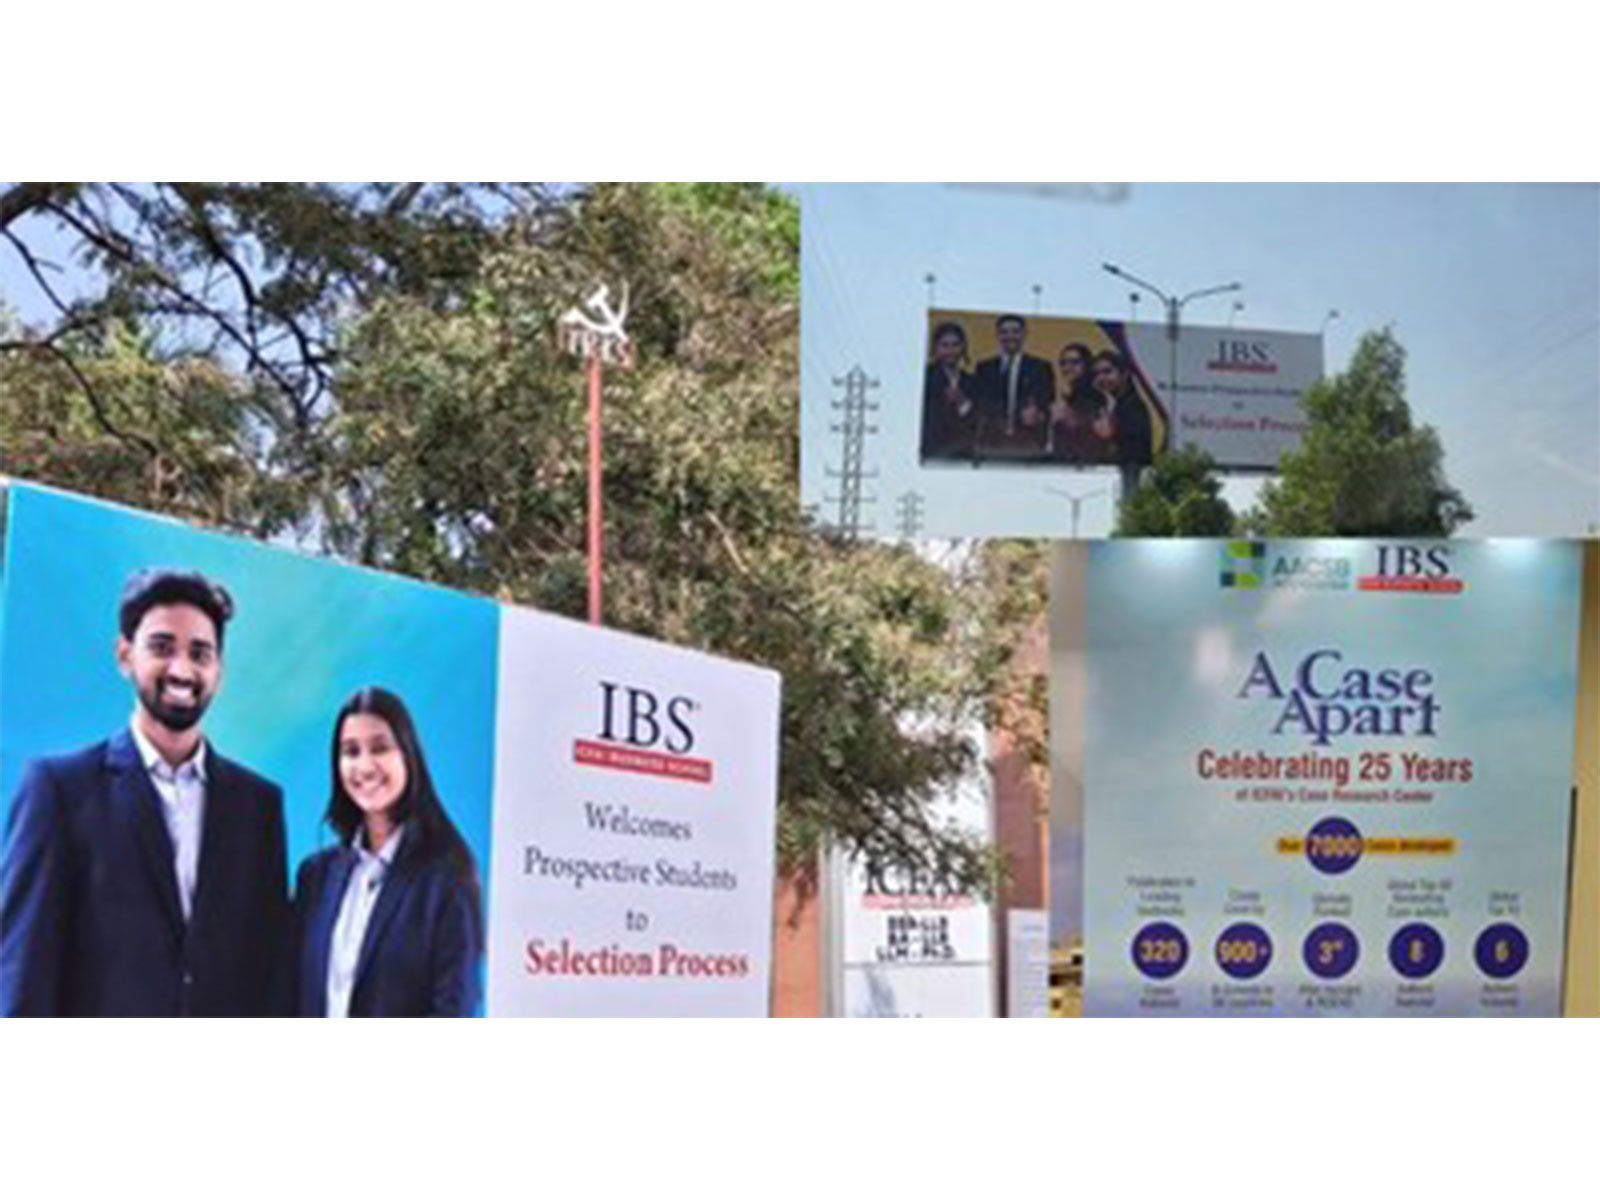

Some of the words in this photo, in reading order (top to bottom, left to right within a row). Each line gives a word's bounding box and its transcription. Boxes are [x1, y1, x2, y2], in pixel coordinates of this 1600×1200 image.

[1218, 340, 1271, 361] IBS
[1376, 545, 1450, 580] IBS
[1236, 651, 1284, 699] A
[1296, 650, 1433, 701] Case
[599, 681, 696, 754] IBS
[1270, 686, 1440, 746] Apart
[1198, 750, 1350, 786] Celebrating
[1359, 753, 1392, 782] 25
[1400, 753, 1473, 783] Years
[1299, 788, 1329, 802] Case
[1332, 789, 1389, 803] Research
[585, 801, 692, 841] Welcomes
[523, 846, 650, 889] Prospective
[655, 859, 738, 891] Students
[625, 909, 649, 932] to
[525, 938, 652, 976] Selection
[658, 945, 749, 978] Process
[1139, 939, 1182, 963] 320
